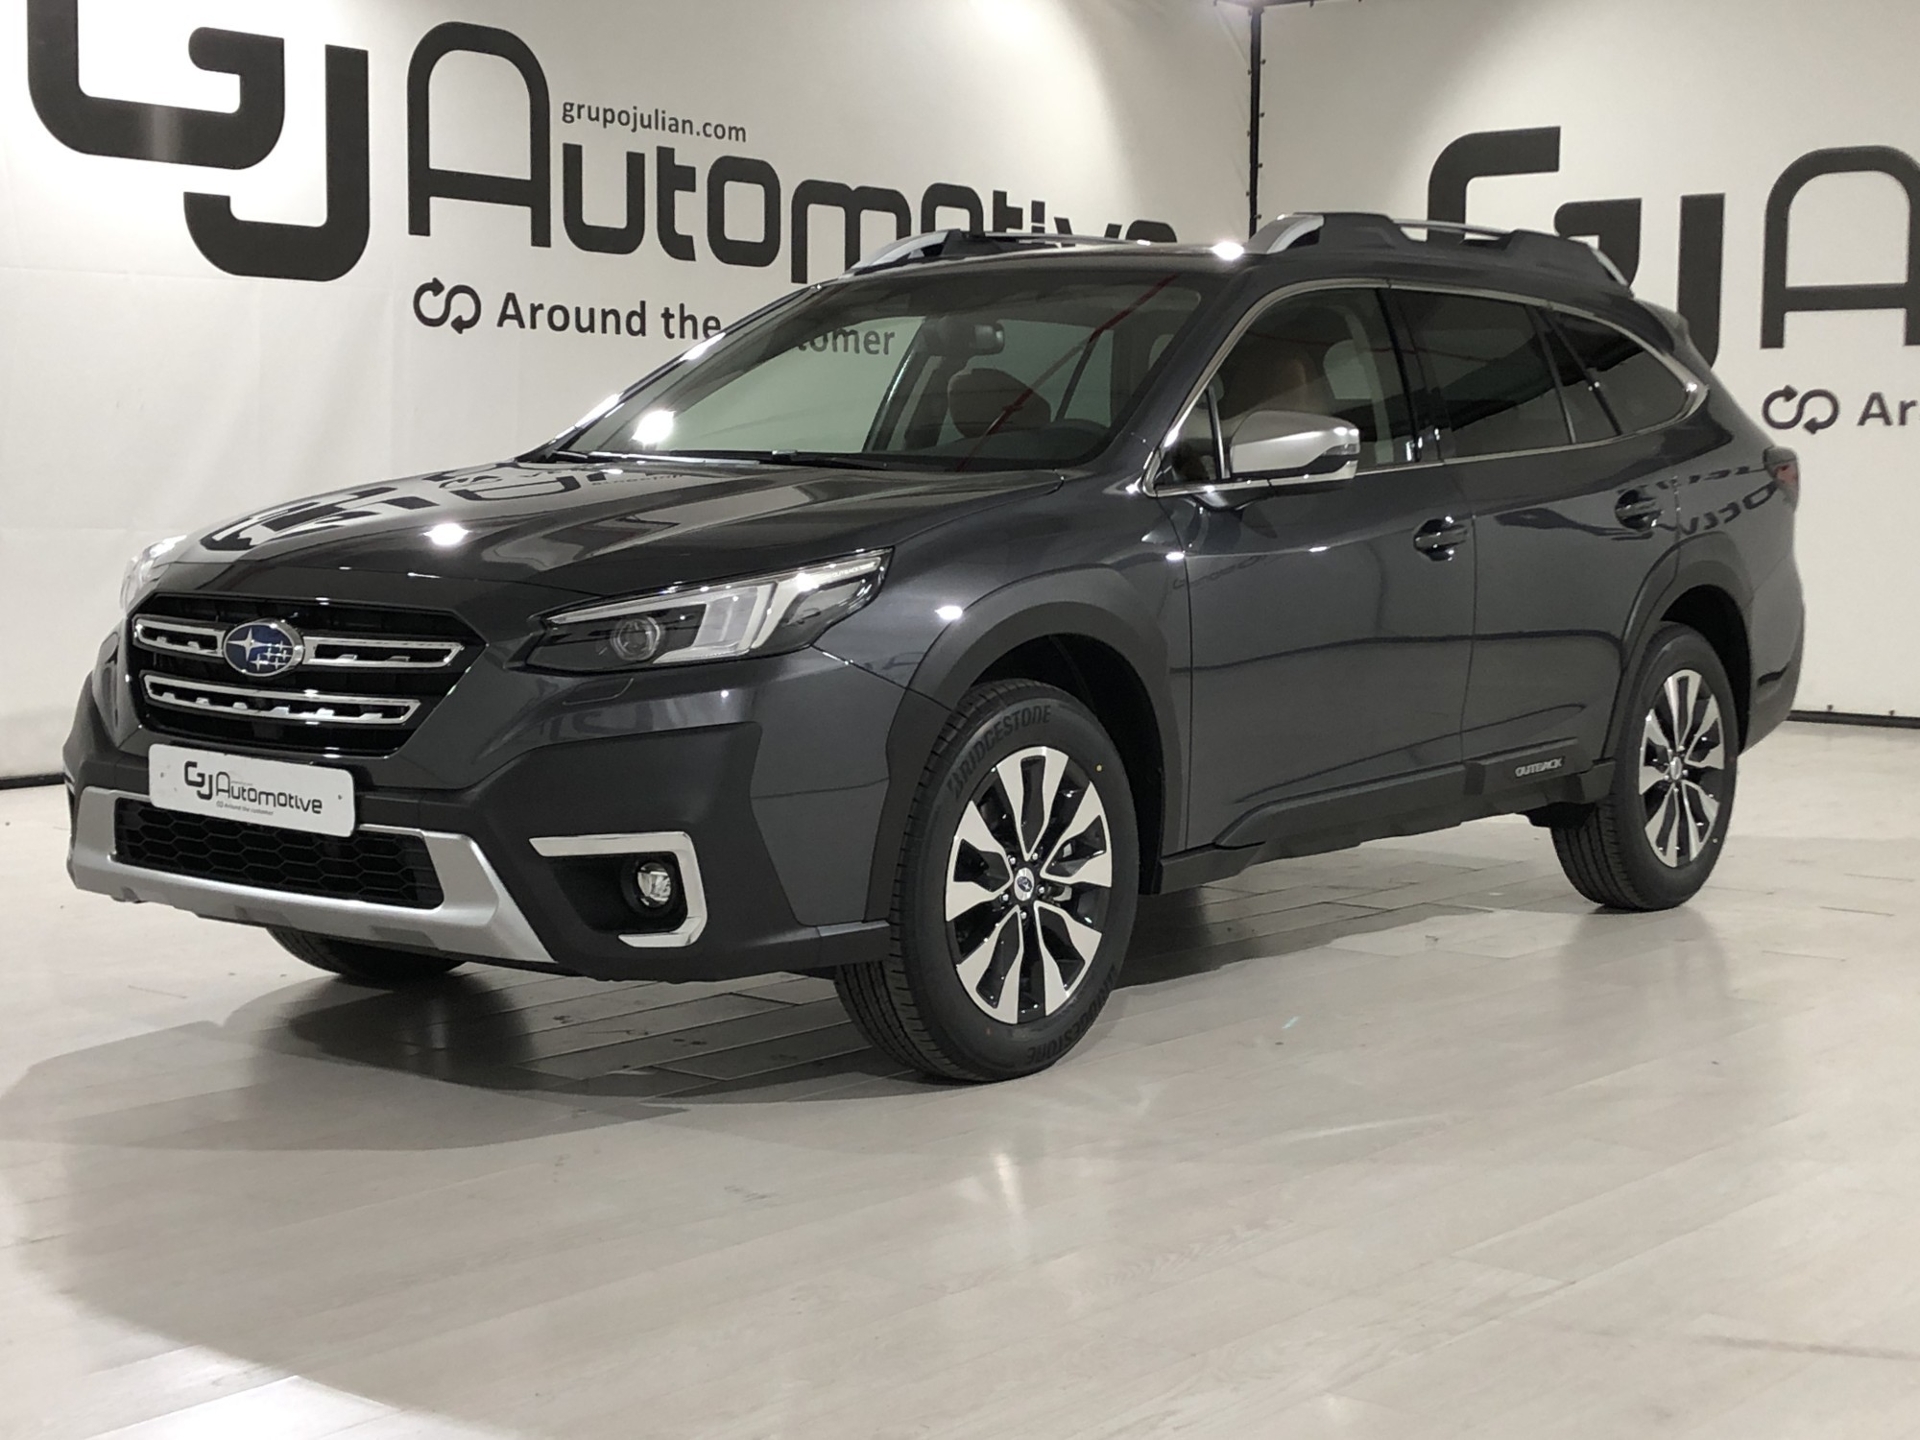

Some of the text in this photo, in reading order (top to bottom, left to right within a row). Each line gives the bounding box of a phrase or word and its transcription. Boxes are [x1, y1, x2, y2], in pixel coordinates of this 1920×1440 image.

[561, 101, 747, 143] grupojulian.com
[407, 21, 1178, 286] Autom
[496, 292, 895, 356] Around the omer
[1515, 758, 1563, 777] OUTBACK
[215, 771, 323, 814] Automotive
